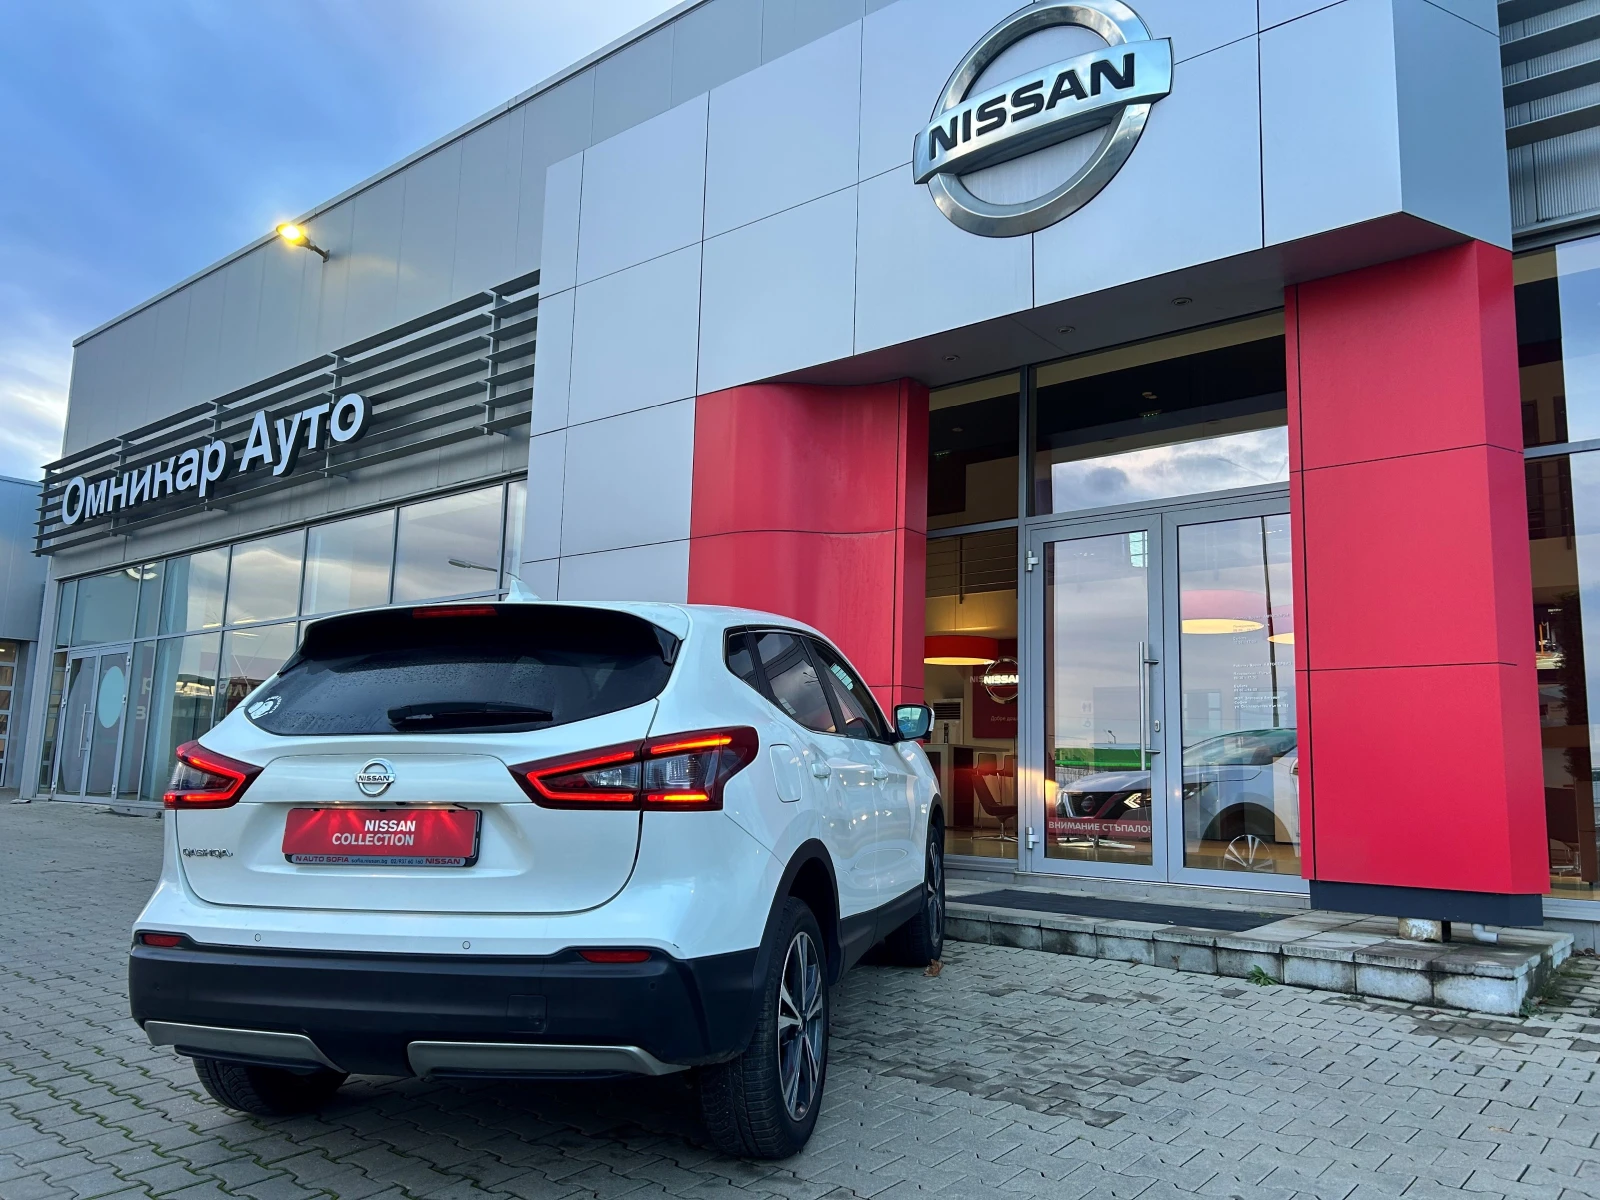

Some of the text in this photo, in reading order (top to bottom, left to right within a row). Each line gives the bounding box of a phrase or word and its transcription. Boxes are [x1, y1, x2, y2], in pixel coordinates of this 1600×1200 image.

[929, 52, 1136, 161] NISSAN
[62, 393, 365, 525] Омникар Ауто
[364, 820, 416, 832] NISSAN
[1048, 821, 1151, 833] ВНИМАНИЕ СТЪПАЛО!
[332, 833, 414, 846] COLLECTION
